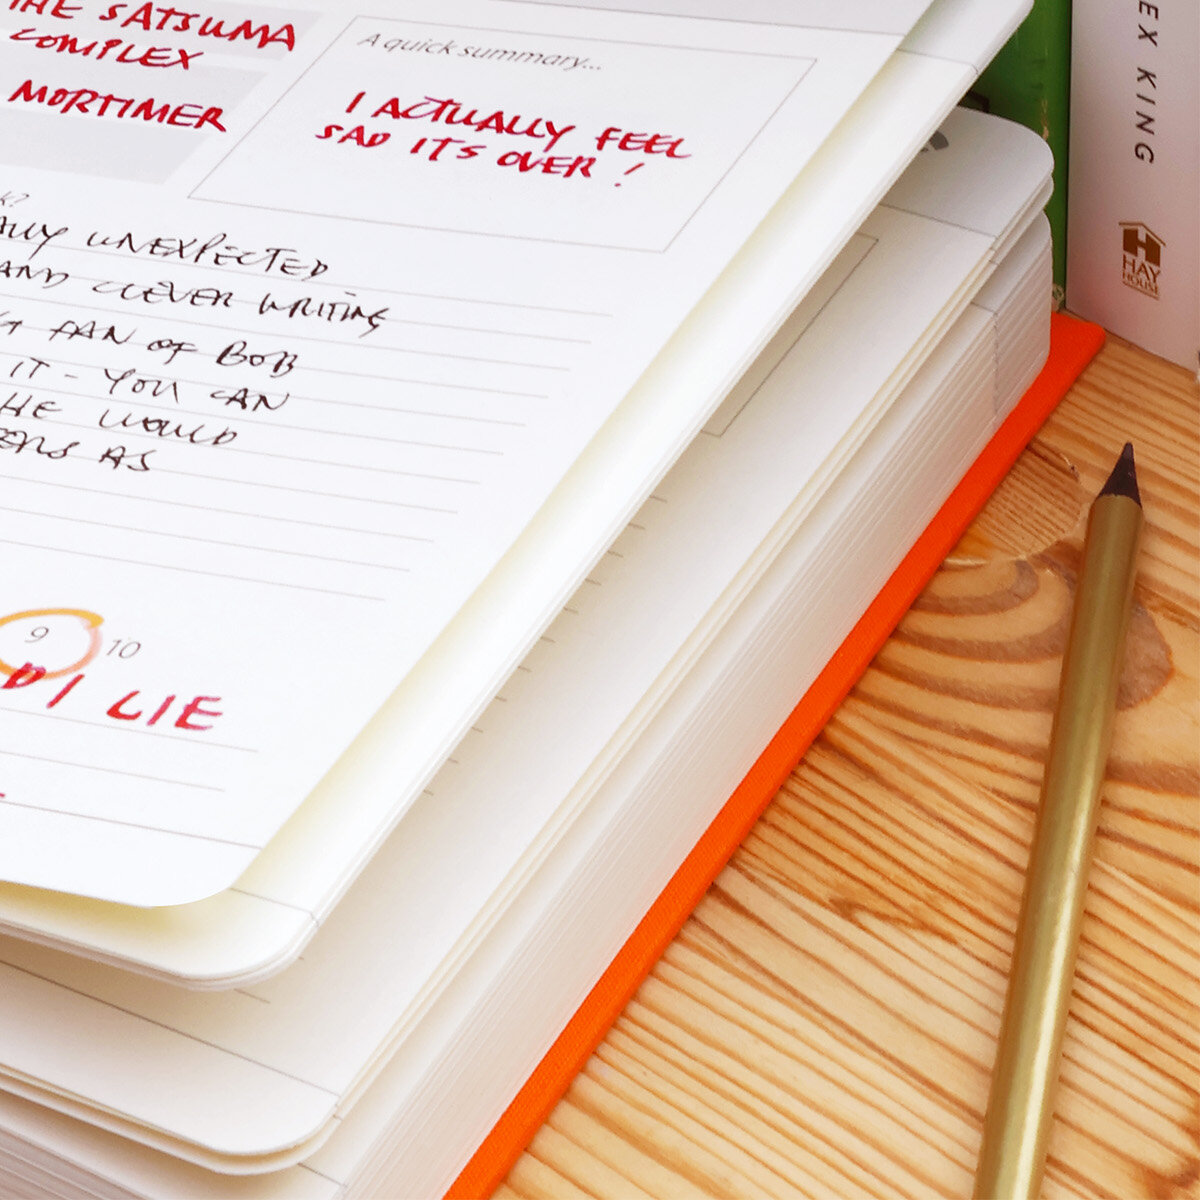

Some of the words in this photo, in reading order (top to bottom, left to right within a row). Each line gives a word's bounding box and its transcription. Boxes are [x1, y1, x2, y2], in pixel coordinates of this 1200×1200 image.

[99, 1, 296, 52] SATSUMA
[9, 28, 204, 70] COMPLEX
[383, 35, 455, 57] quick
[457, 43, 603, 71] summary...
[7, 79, 227, 133] MORTIMER
[345, 91, 367, 114] I
[371, 95, 576, 153] ACTUALLY
[594, 126, 693, 159] FEEL
[1134, 66, 1157, 164] KING
[315, 124, 392, 148] SAD
[87, 232, 329, 282] UNEXPECTED
[1123, 254, 1161, 283] HAY
[215, 341, 298, 378] BOB
[104, 368, 179, 403] YOU
[210, 387, 290, 412] CAN
[99, 446, 158, 473] AS
[24, 625, 50, 644] 9
[106, 638, 142, 660] 10
[107, 690, 224, 730] LIE
